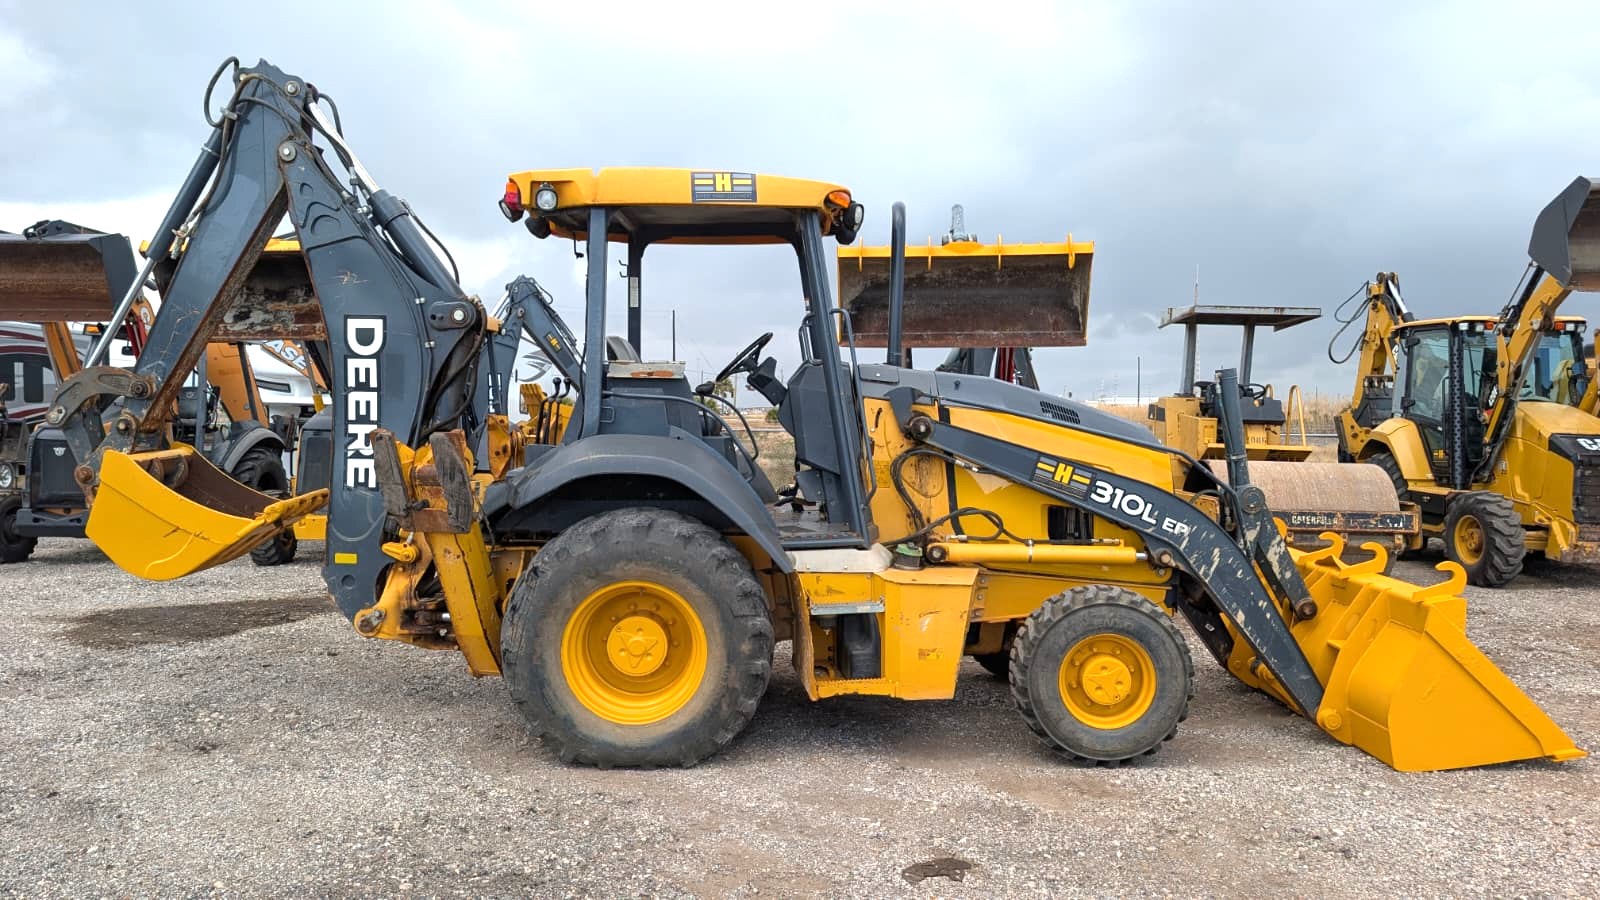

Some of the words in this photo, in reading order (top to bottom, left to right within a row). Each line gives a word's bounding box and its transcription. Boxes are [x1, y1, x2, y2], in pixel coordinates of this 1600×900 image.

[264, 339, 307, 370] ASE
[346, 318, 384, 488] DEERE
[1090, 480, 1157, 525] 310L
